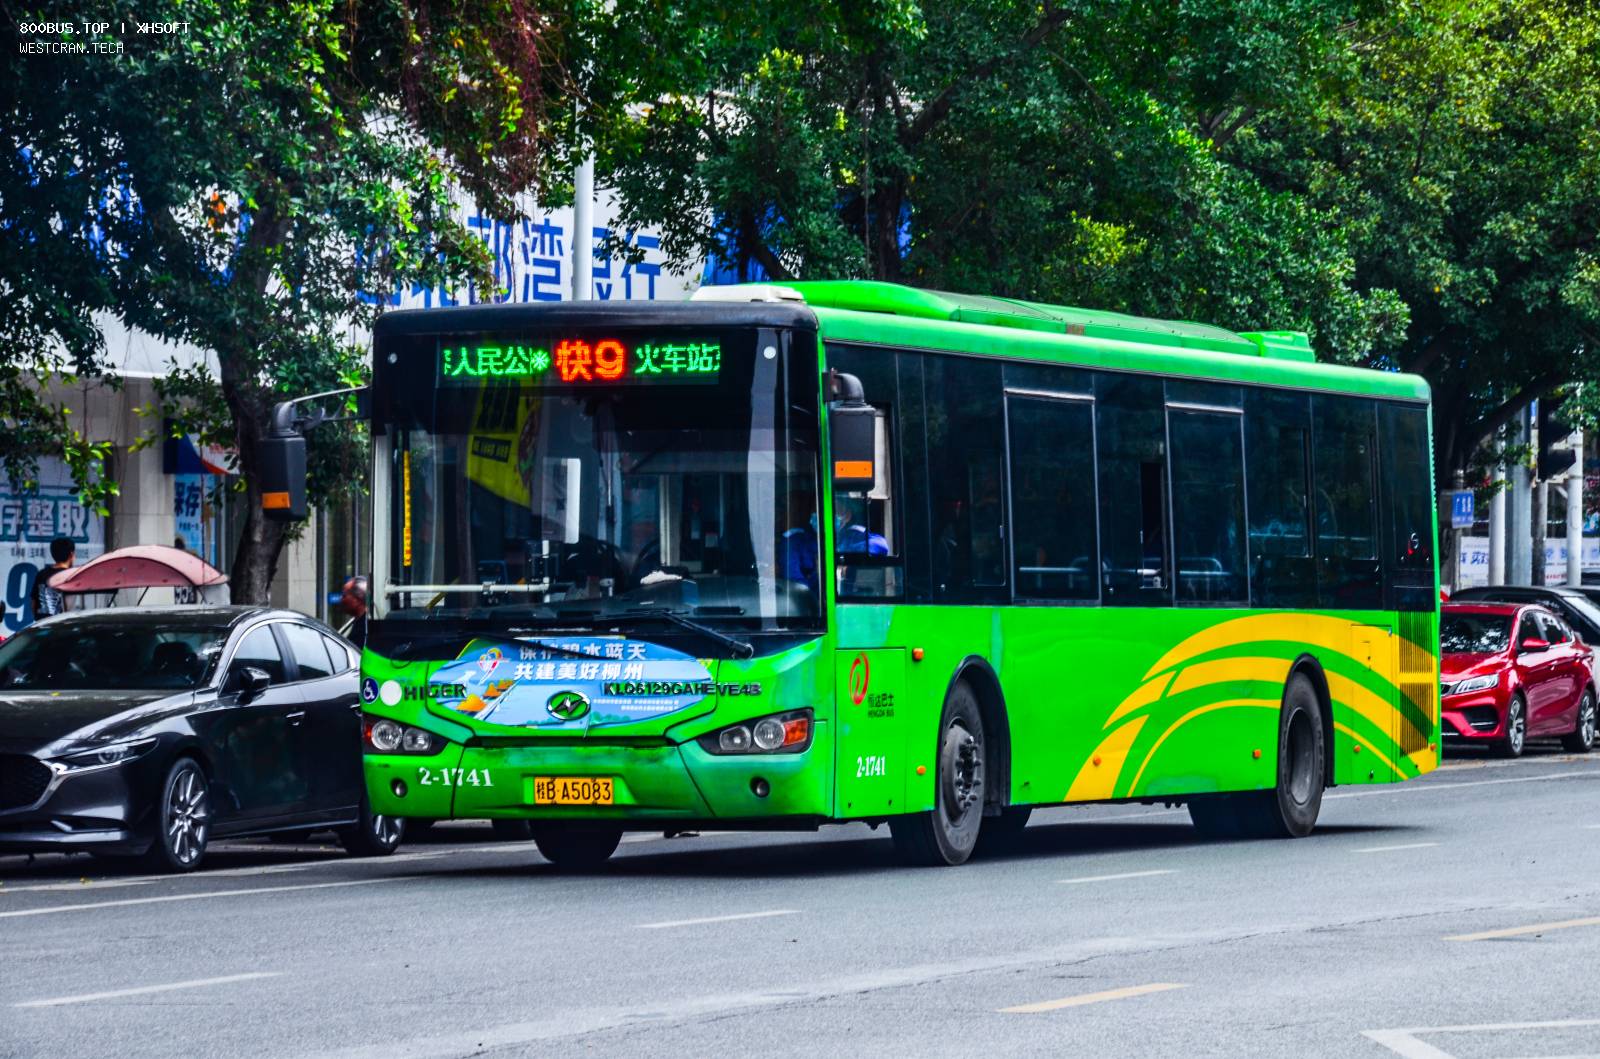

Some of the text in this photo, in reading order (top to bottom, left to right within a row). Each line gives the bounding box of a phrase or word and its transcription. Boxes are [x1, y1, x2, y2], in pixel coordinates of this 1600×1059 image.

[444, 346, 533, 376] 人民公
[556, 340, 624, 381] 快9
[514, 663, 643, 680] 共建美好柳州
[404, 684, 466, 700] HIGER
[856, 756, 886, 777] 2-1741
[418, 767, 493, 786] 2-1741
